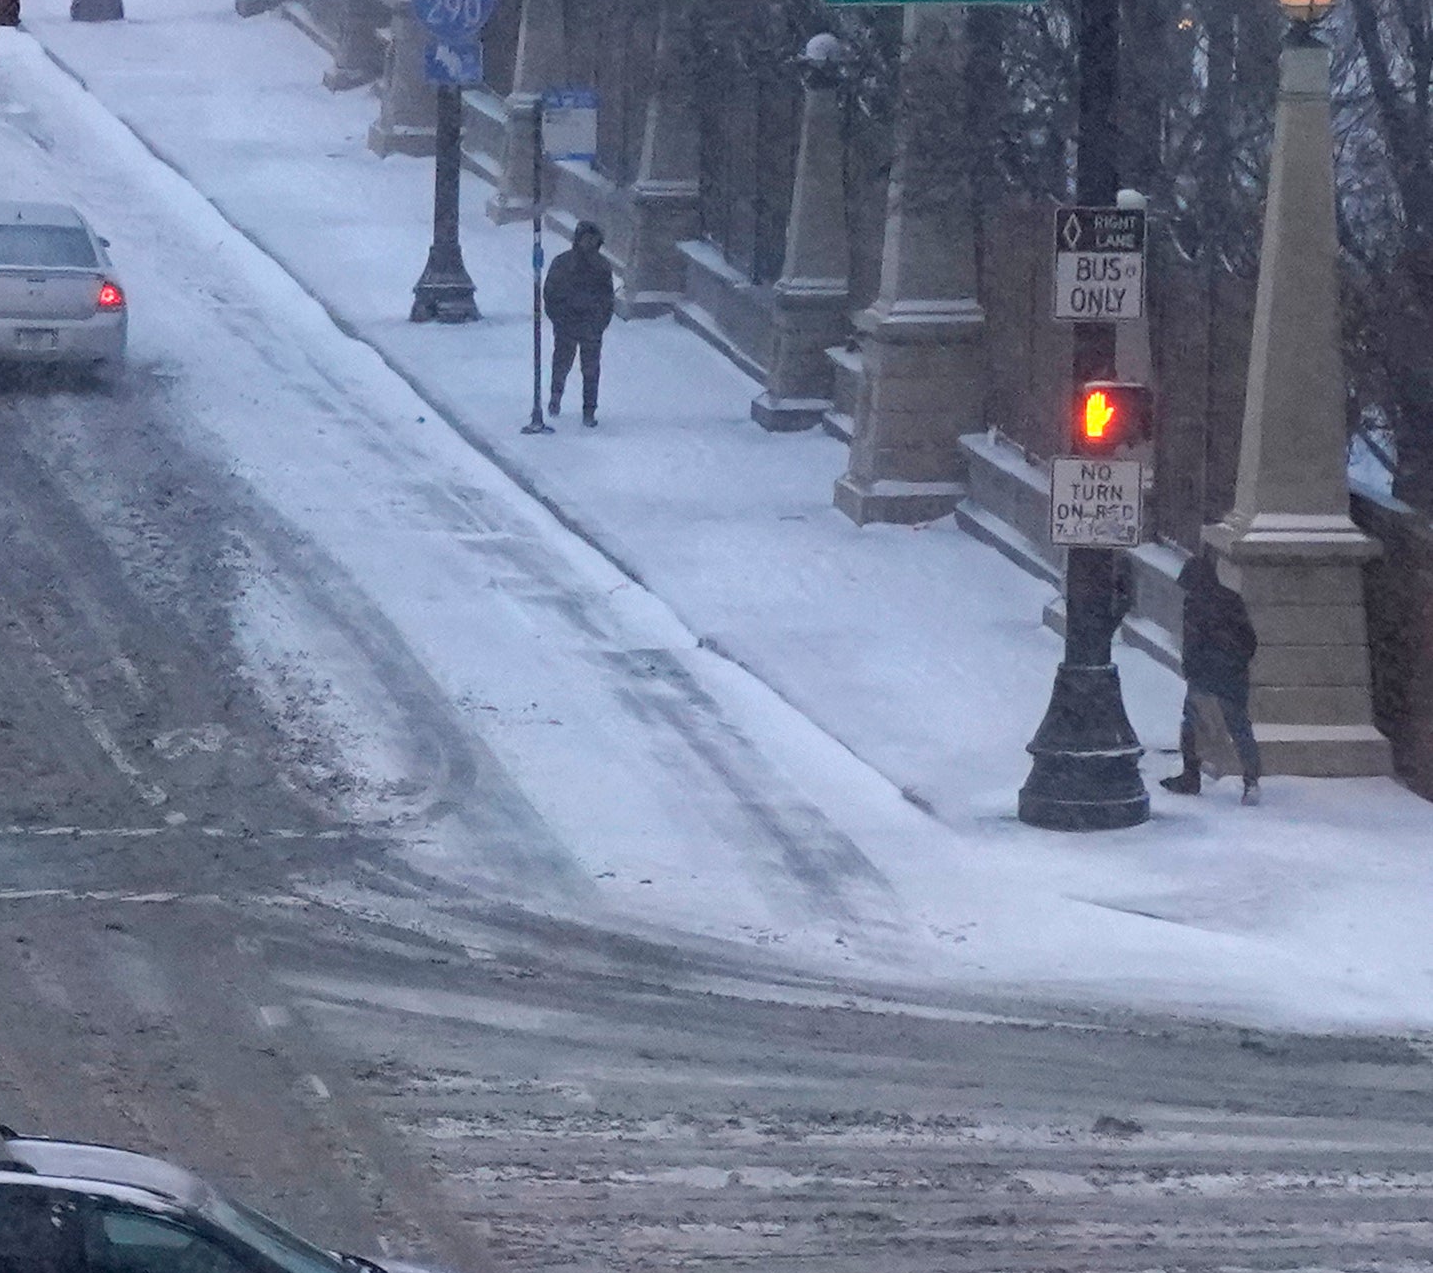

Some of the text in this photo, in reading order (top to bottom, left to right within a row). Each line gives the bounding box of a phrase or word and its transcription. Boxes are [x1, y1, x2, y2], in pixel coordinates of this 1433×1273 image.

[1093, 214, 1137, 229] RIGHT
[1095, 234, 1135, 247] LANE
[1076, 256, 1121, 281] BUS
[1070, 287, 1126, 317] ONLY
[1081, 463, 1112, 481] NO
[1069, 482, 1123, 501] TURN
[1057, 503, 1134, 521] ON RED
